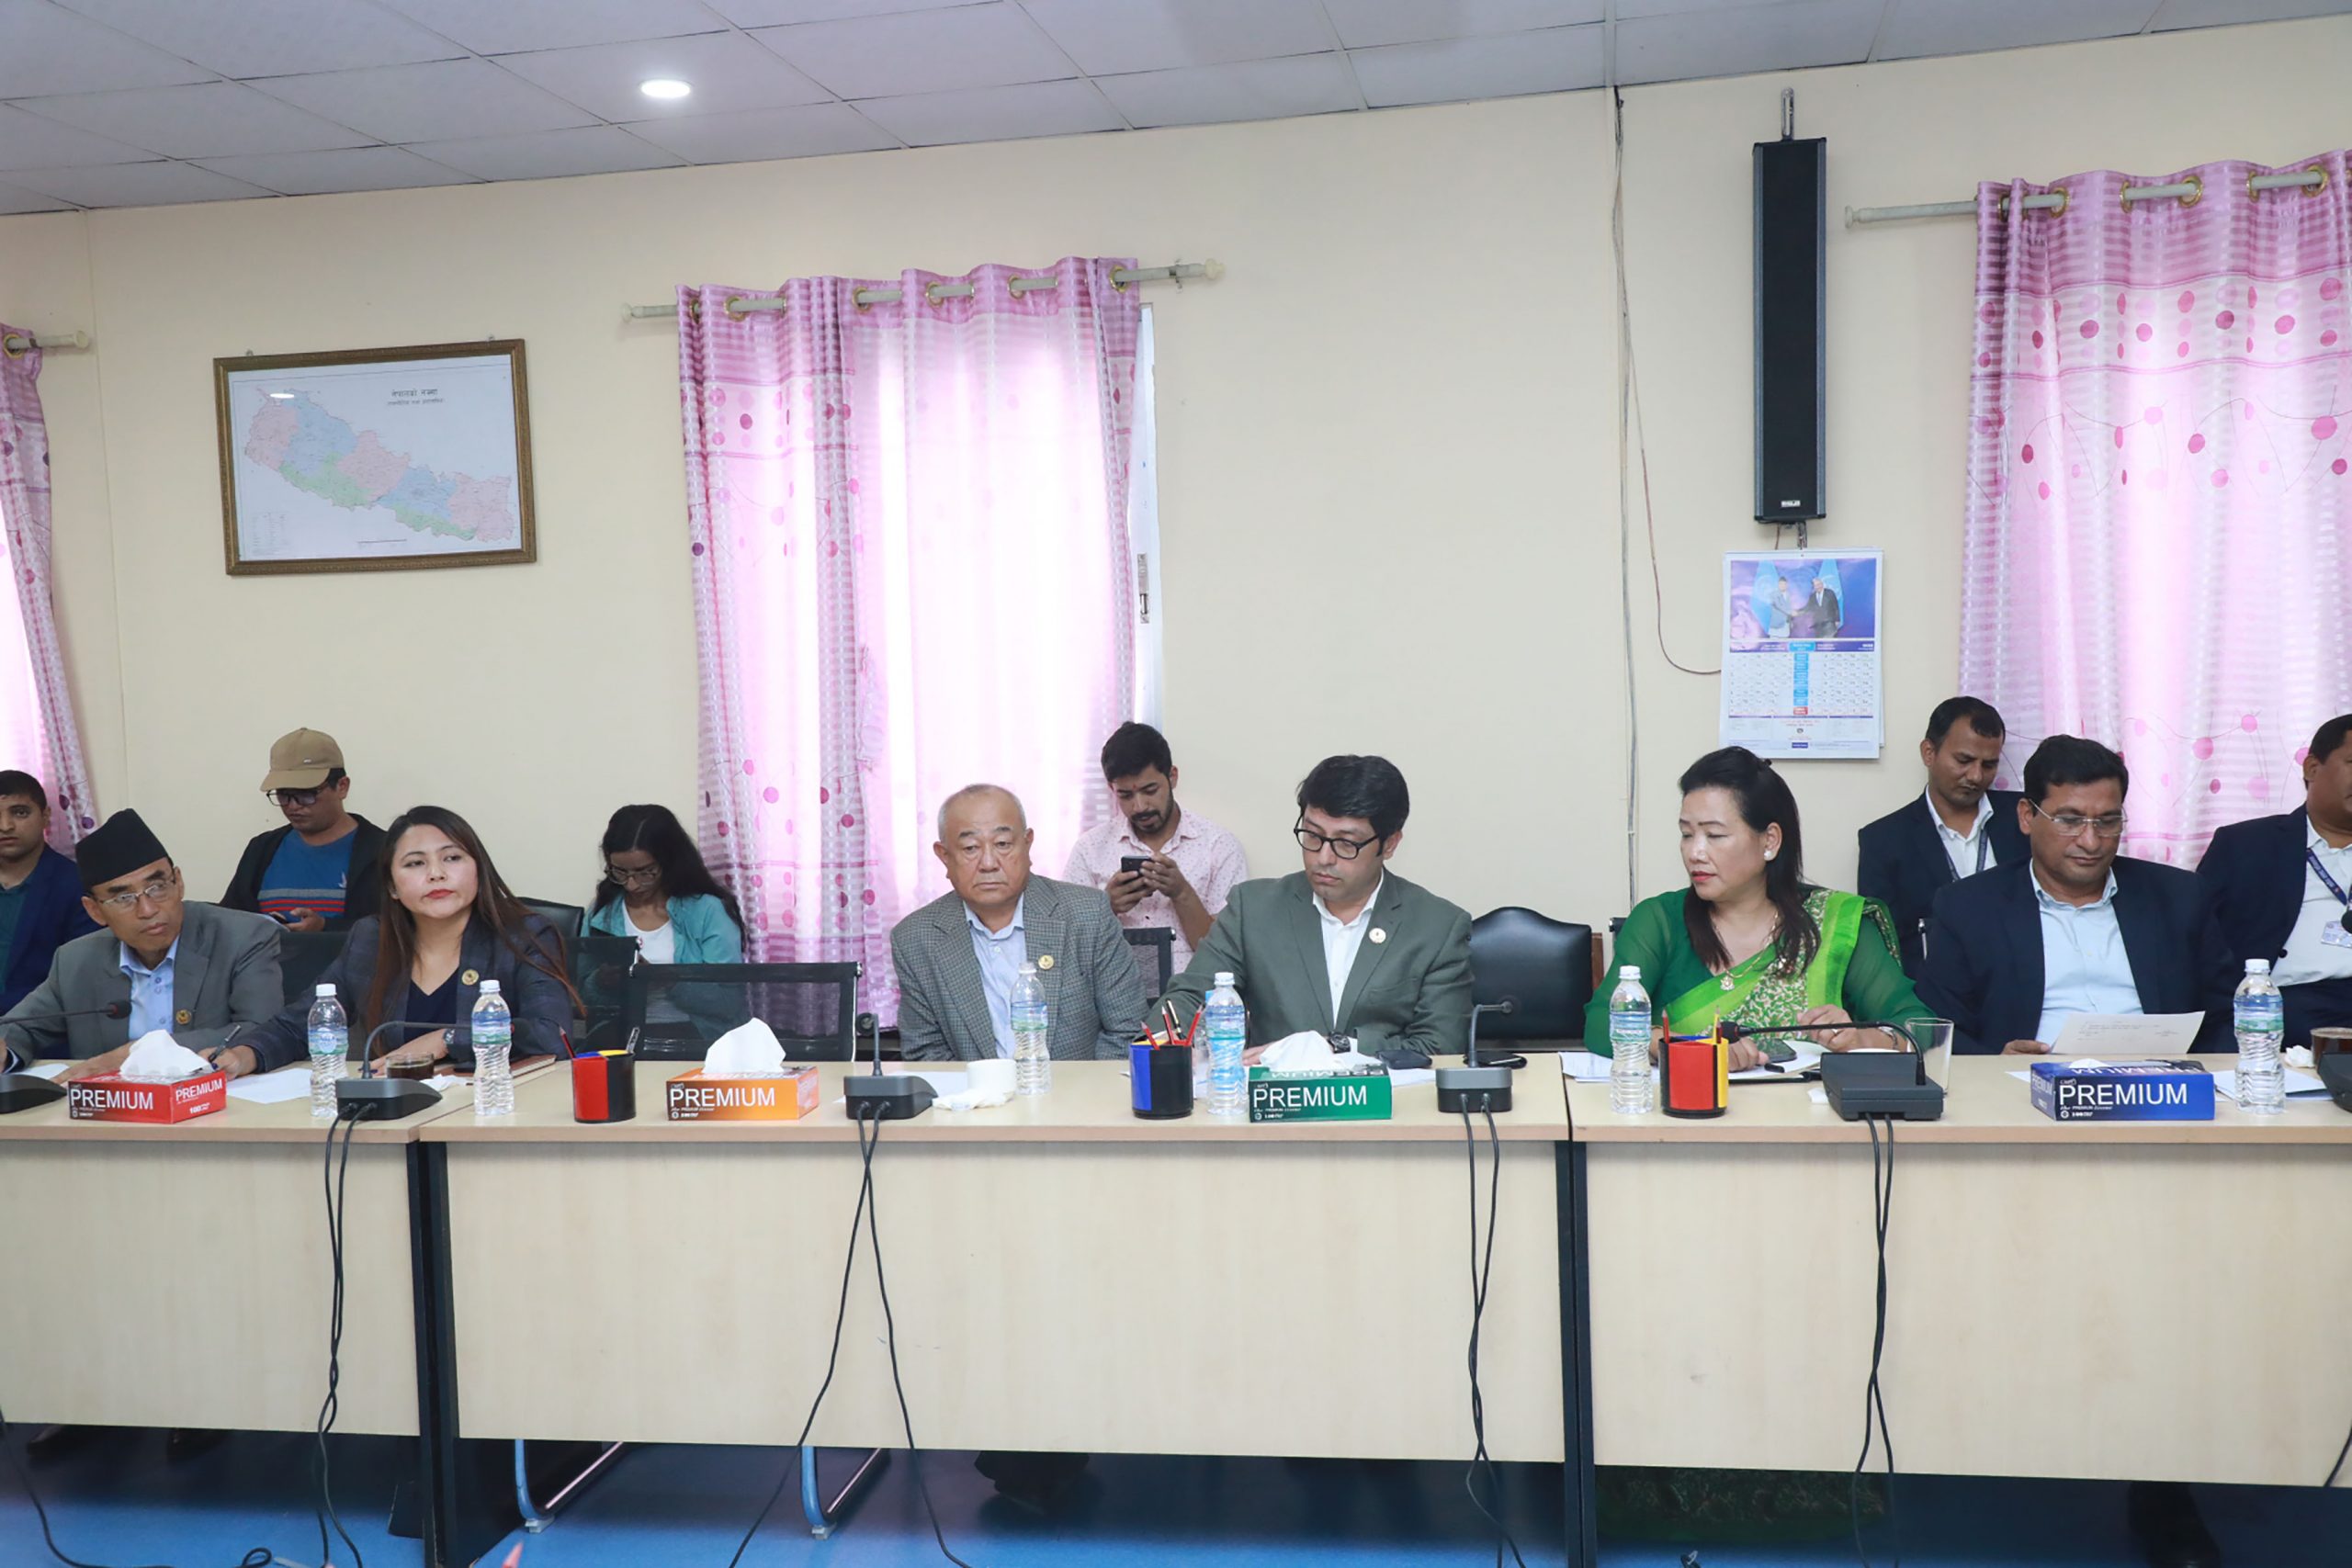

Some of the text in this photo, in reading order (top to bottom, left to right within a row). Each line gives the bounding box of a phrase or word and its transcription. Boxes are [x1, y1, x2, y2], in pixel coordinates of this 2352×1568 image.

[70, 1089, 153, 1110] PREMIUM
[175, 1078, 223, 1101] PREMIUM
[670, 1087, 775, 1108] PREMIUM
[1253, 1085, 1368, 1108] PREMIUM
[2059, 1083, 2188, 1105] PREMIUM
